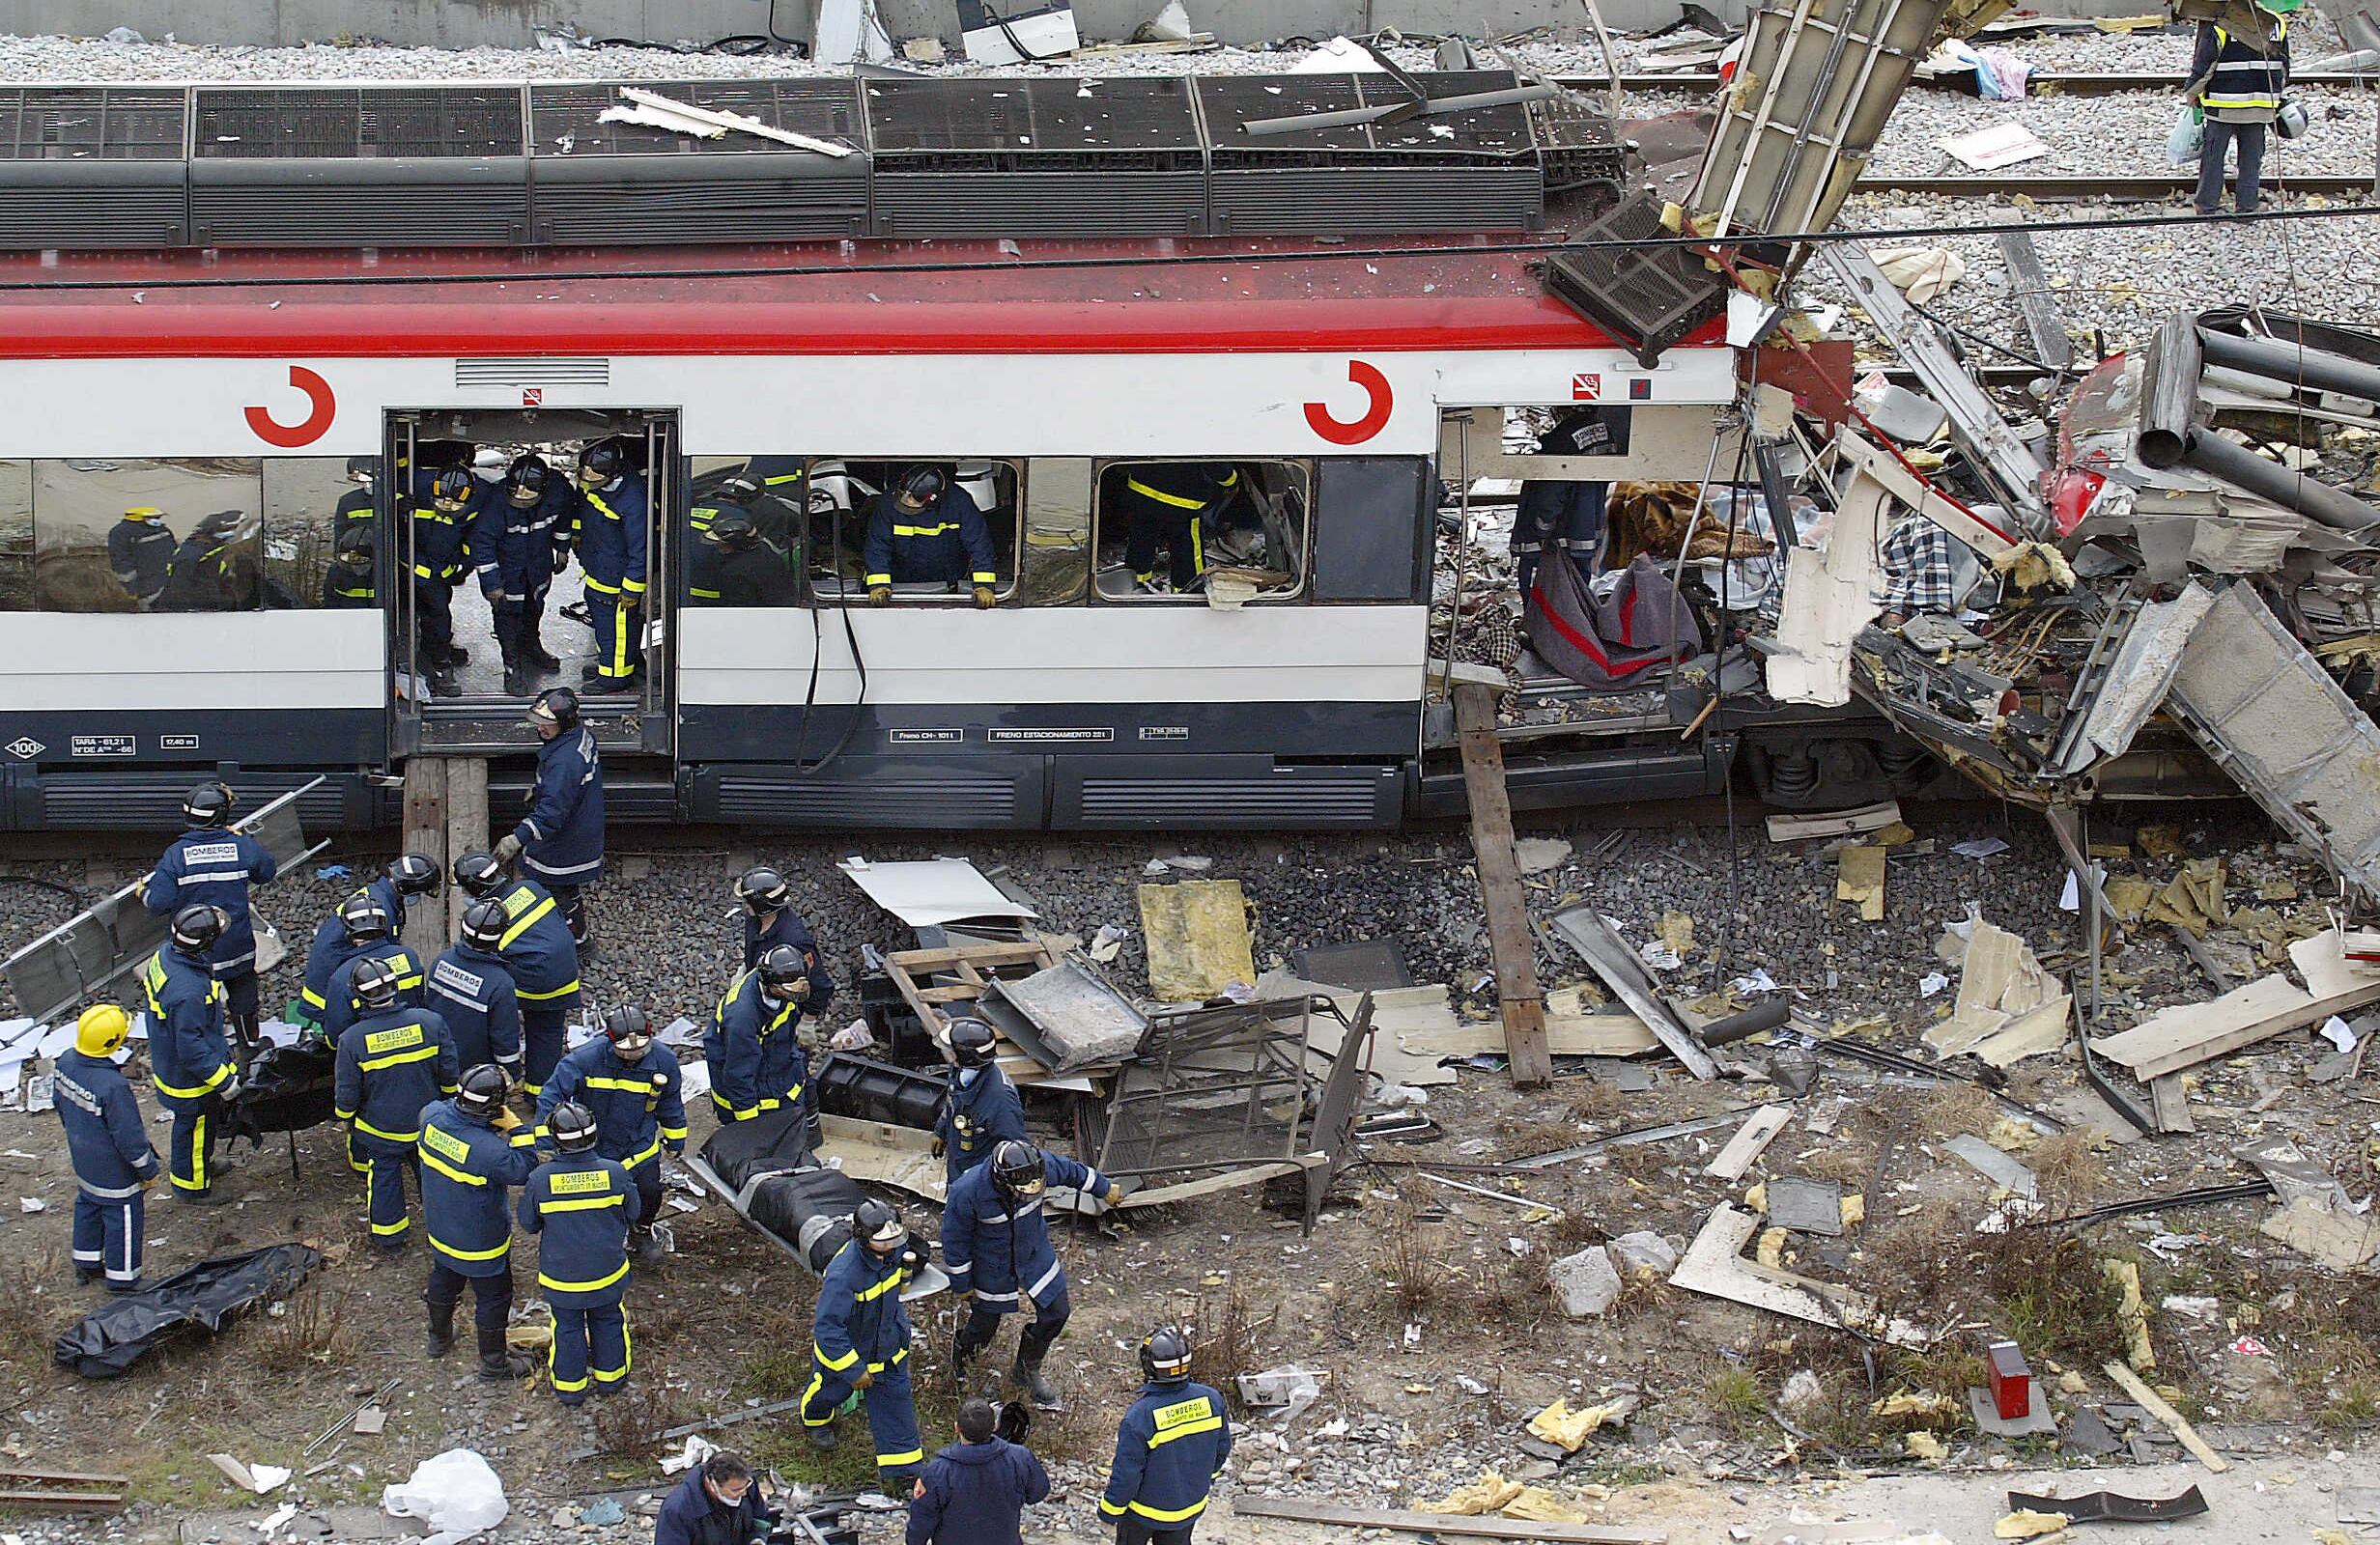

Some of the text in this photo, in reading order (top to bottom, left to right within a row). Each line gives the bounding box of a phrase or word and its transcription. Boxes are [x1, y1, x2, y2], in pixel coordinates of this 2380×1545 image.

[186, 846, 236, 857] BOMBEROS
[438, 963, 480, 988] BOMBEROS
[376, 1027, 412, 1043] BOMBEROS
[431, 1130, 461, 1151] BOMBEROS
[561, 1172, 599, 1184] BOMBEROS
[1165, 1401, 1203, 1419] BOMBEROS
